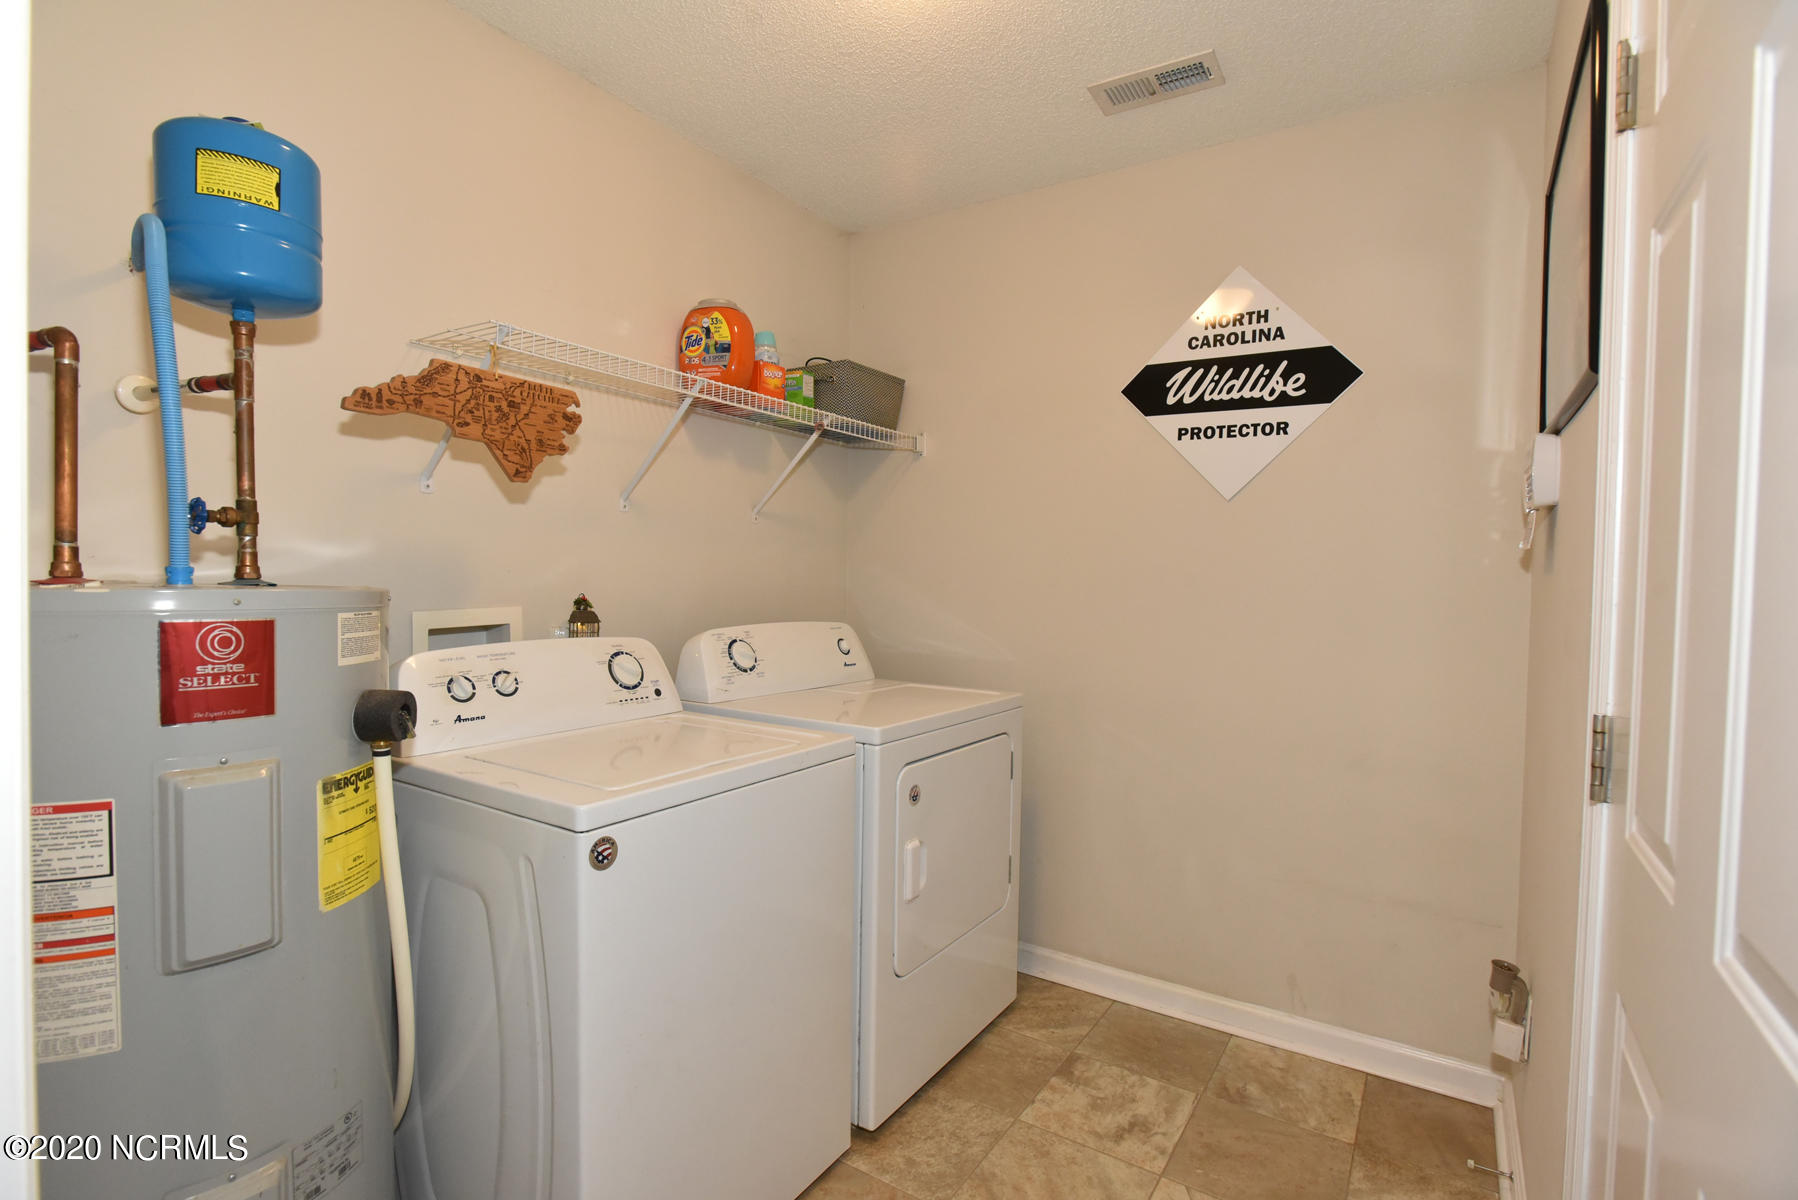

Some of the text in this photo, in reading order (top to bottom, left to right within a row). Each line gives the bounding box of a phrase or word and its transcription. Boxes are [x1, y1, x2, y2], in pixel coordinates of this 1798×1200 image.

[201, 186, 274, 207] WARNING!
[1204, 309, 1270, 331] NORTH
[685, 334, 703, 351] Tide
[1187, 326, 1286, 351] CAROLINA
[1165, 359, 1307, 406] Wildlife
[1177, 421, 1290, 441] PROTECTOR
[196, 663, 245, 674] state
[179, 673, 259, 688] SELECT
[454, 714, 486, 724] Amana
